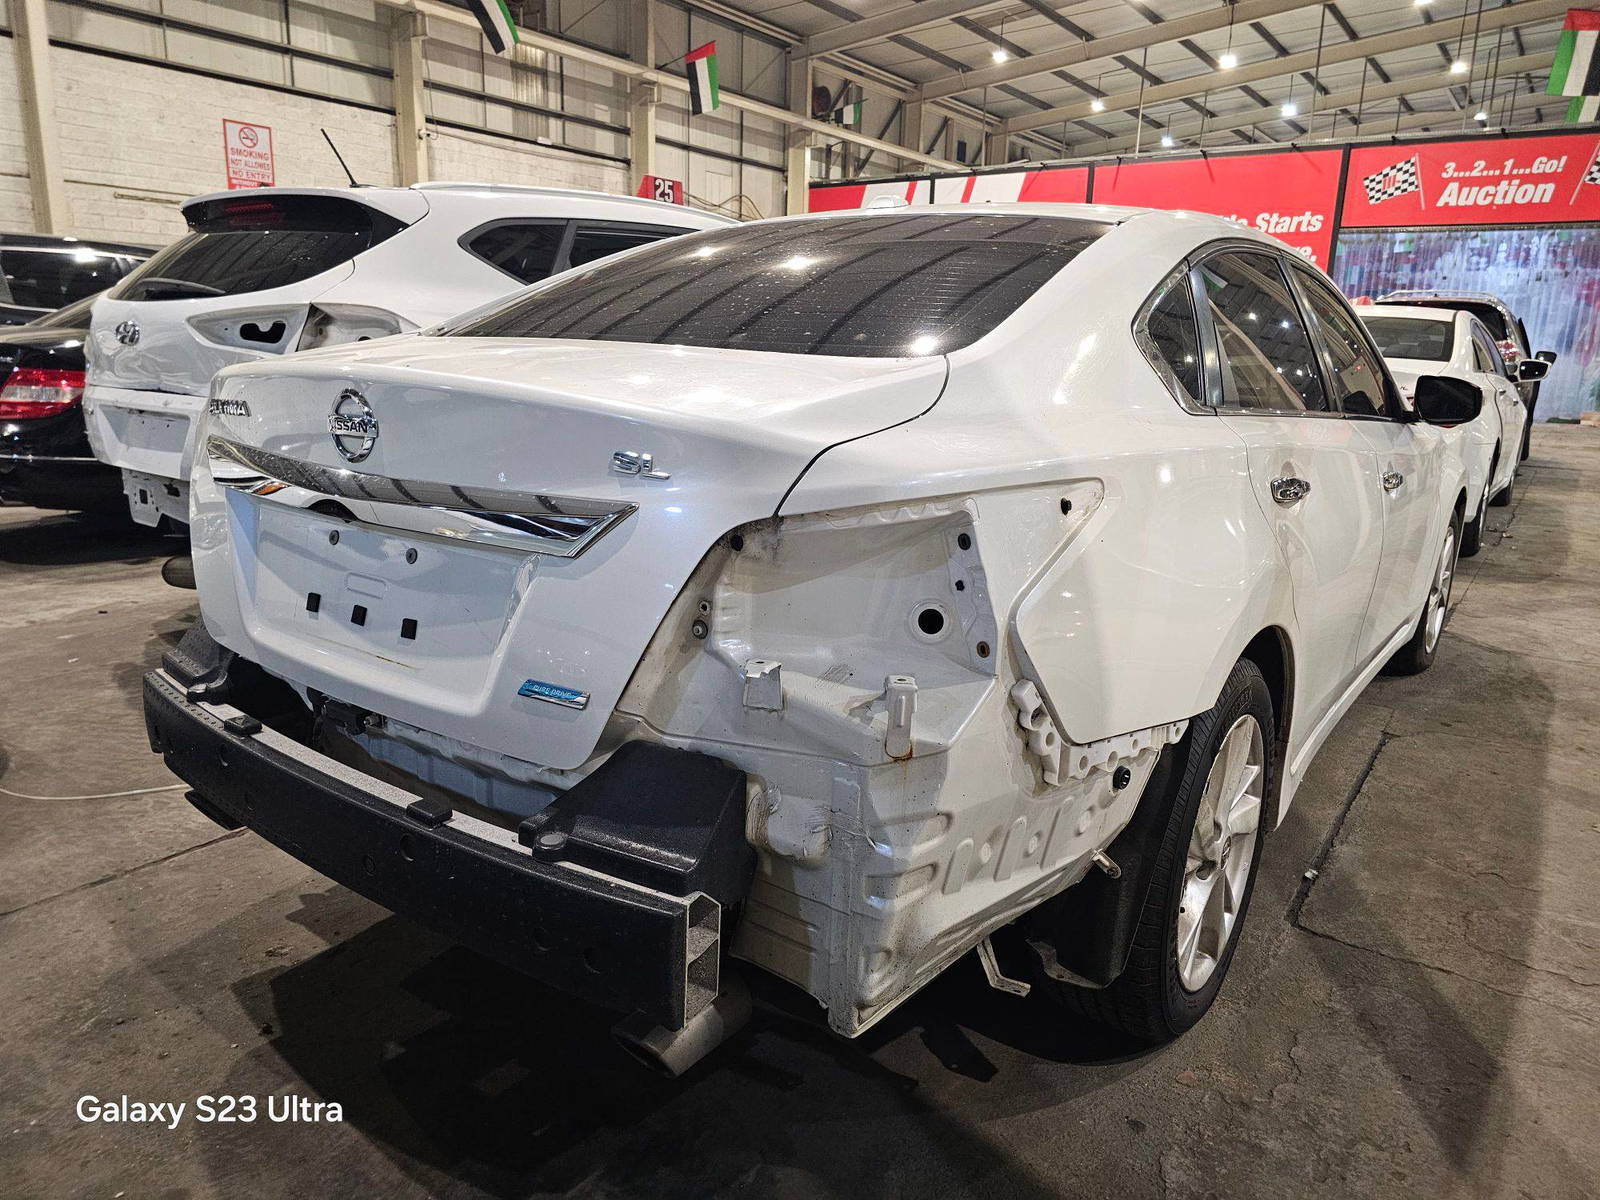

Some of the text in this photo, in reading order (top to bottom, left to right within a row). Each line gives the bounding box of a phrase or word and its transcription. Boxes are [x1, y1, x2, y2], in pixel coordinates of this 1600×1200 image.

[230, 148, 269, 160] SMOKING
[231, 158, 271, 170] NOT ALLOWED
[232, 169, 271, 181] NO ENTRY
[655, 178, 674, 203] 25
[1436, 179, 1556, 207] Auction
[1256, 211, 1324, 233] Starts
[612, 450, 672, 481] SL
